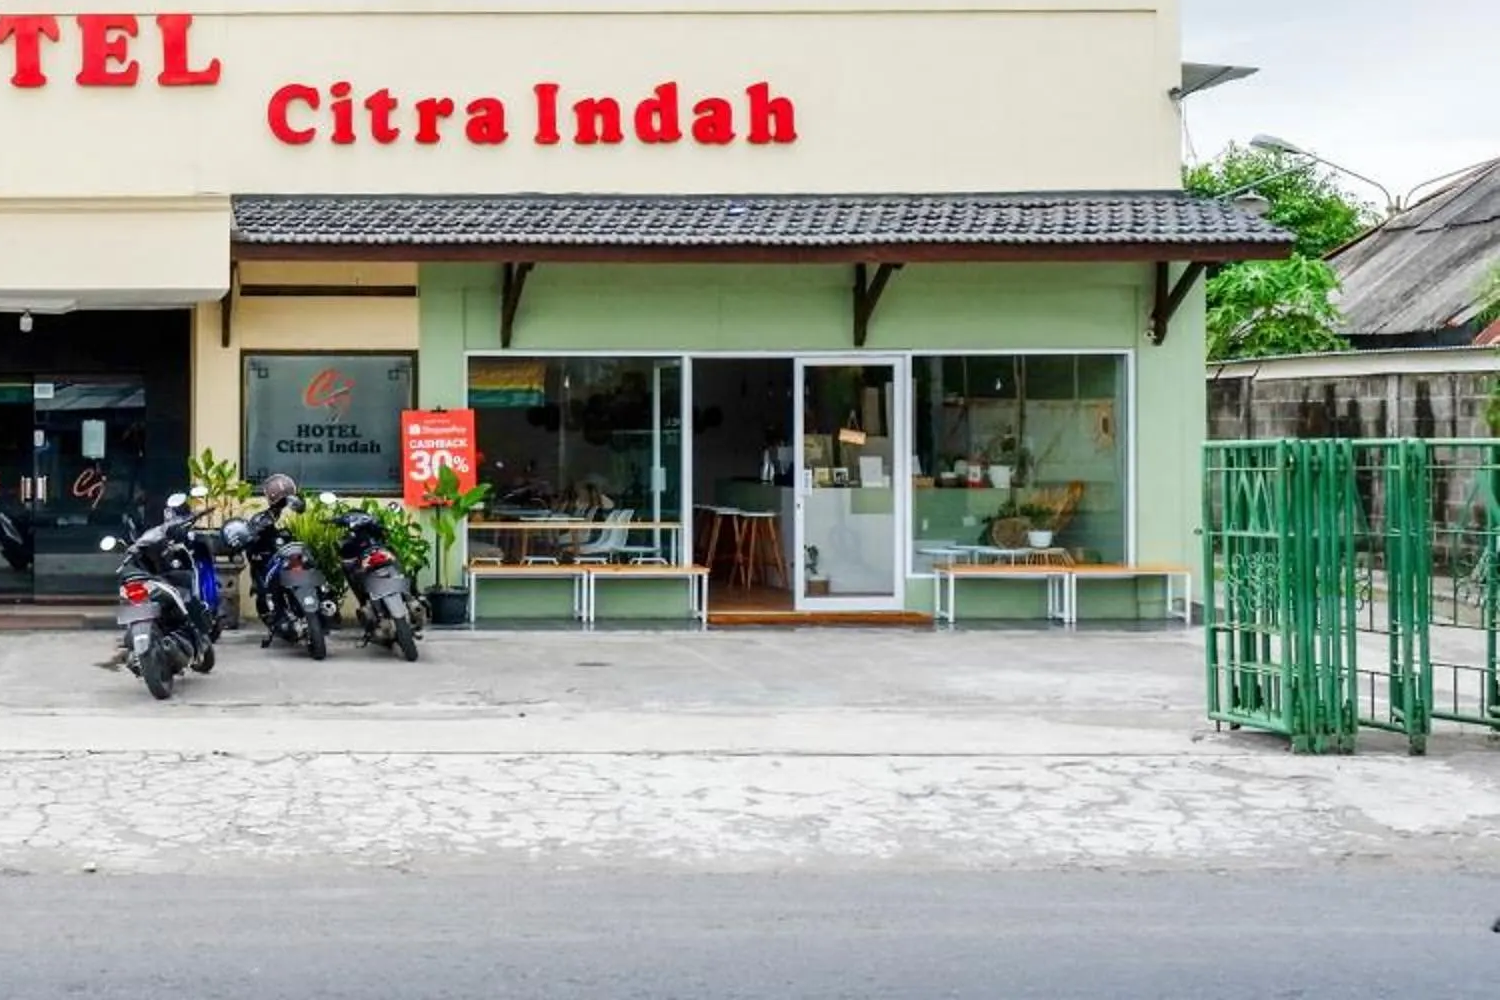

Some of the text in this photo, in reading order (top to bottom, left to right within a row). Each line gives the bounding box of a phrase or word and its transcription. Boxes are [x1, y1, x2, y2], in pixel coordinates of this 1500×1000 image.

[266, 79, 799, 148] Citra Indah
[296, 424, 363, 439] HOTEL
[275, 439, 382, 455] Citra Indah
